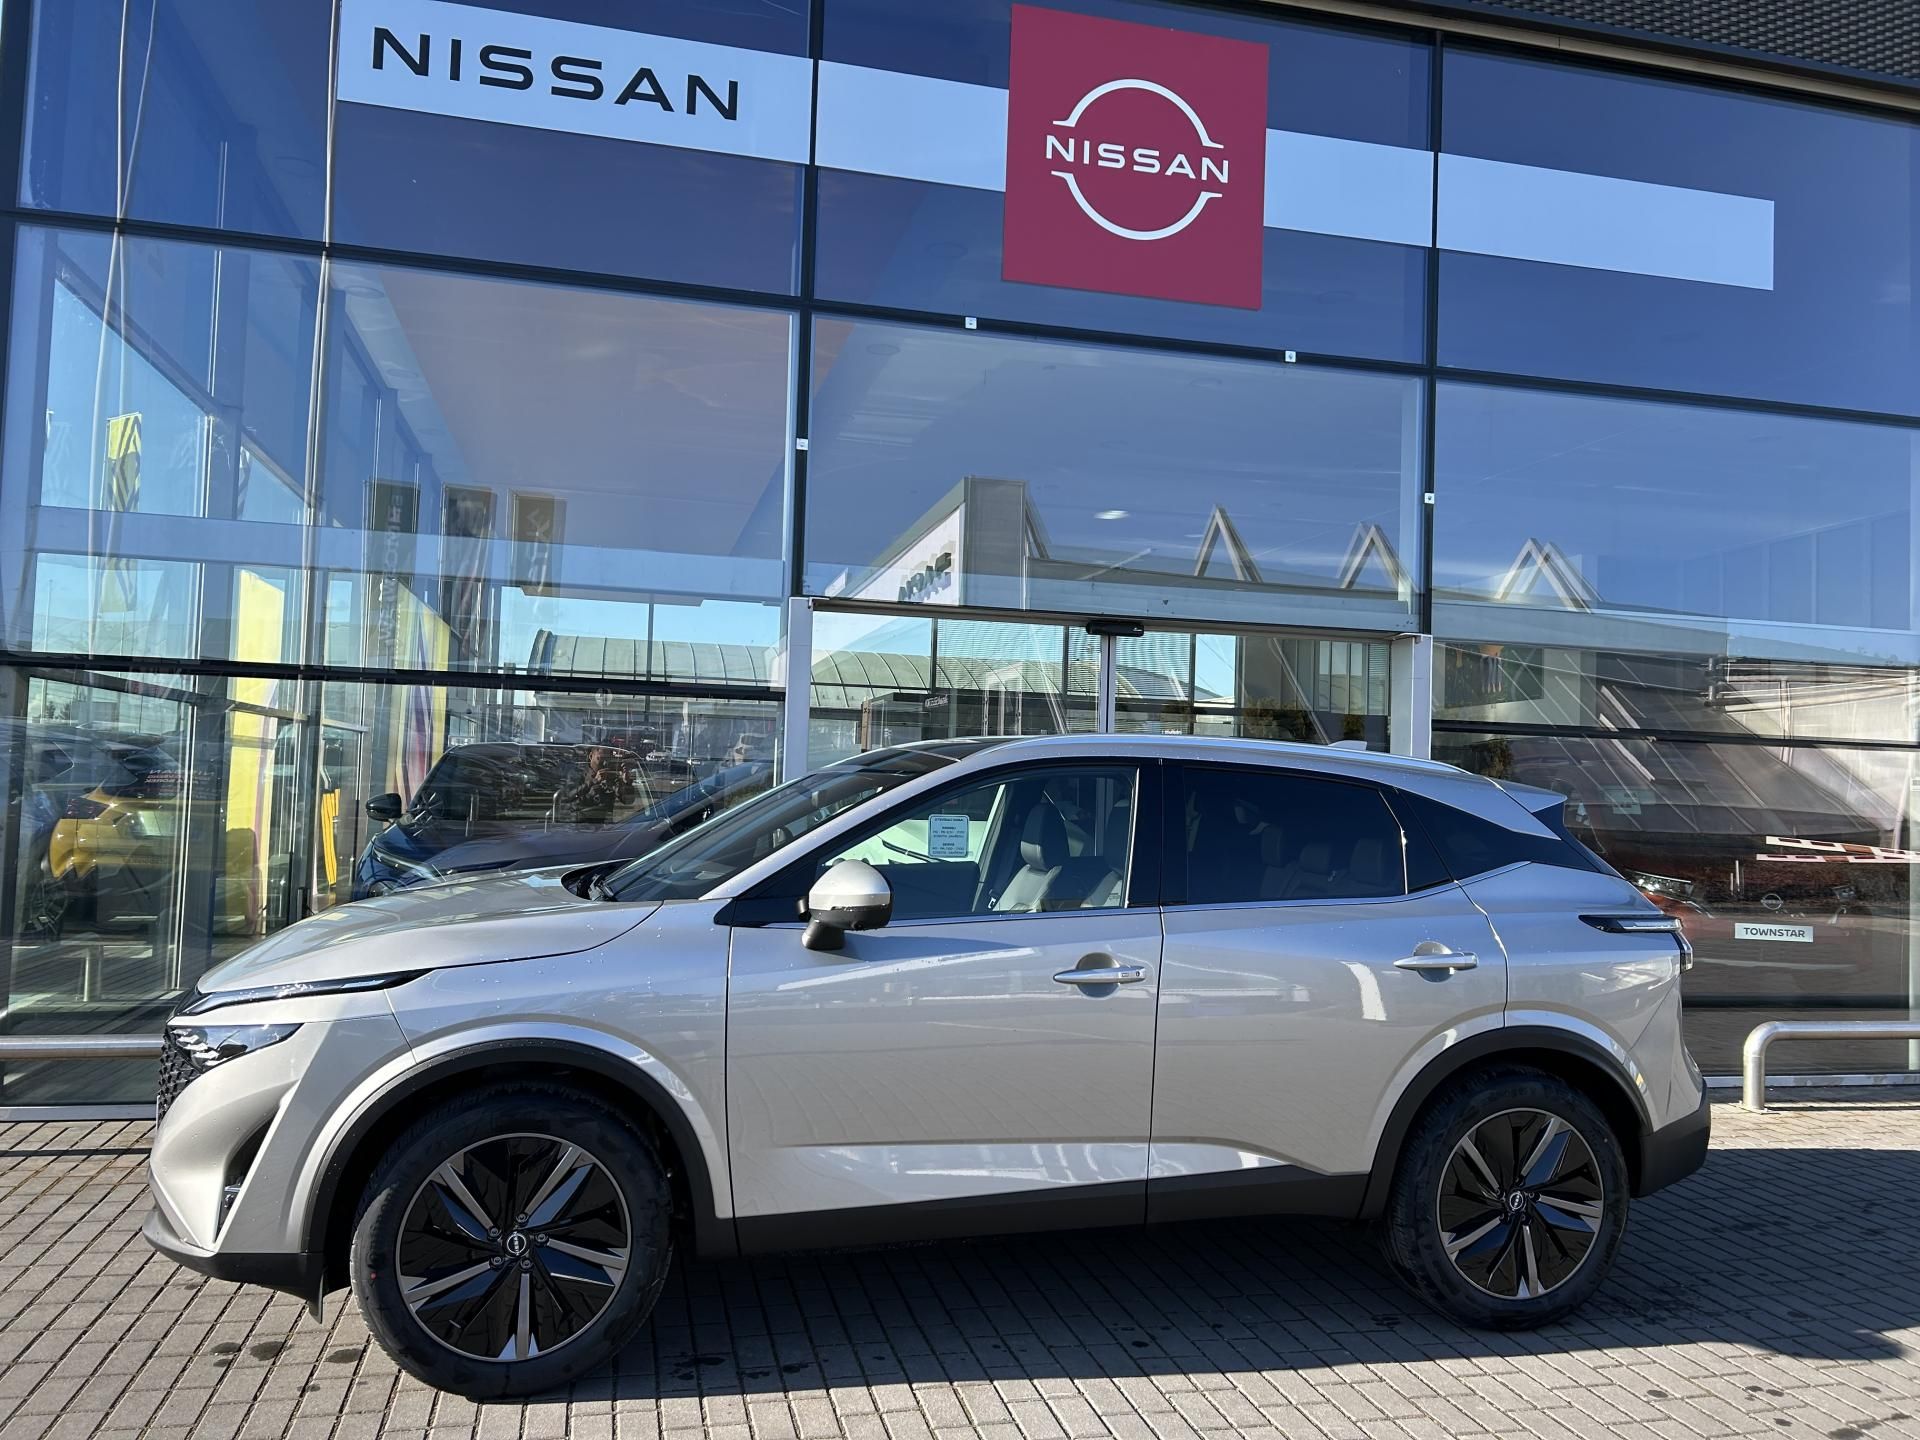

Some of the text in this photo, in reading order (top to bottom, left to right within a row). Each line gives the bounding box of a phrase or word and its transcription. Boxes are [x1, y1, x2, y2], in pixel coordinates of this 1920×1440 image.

[373, 27, 738, 120] NISSAN
[1046, 135, 1229, 183] NISSAN
[1743, 927, 1805, 938] TOWNSTAR
